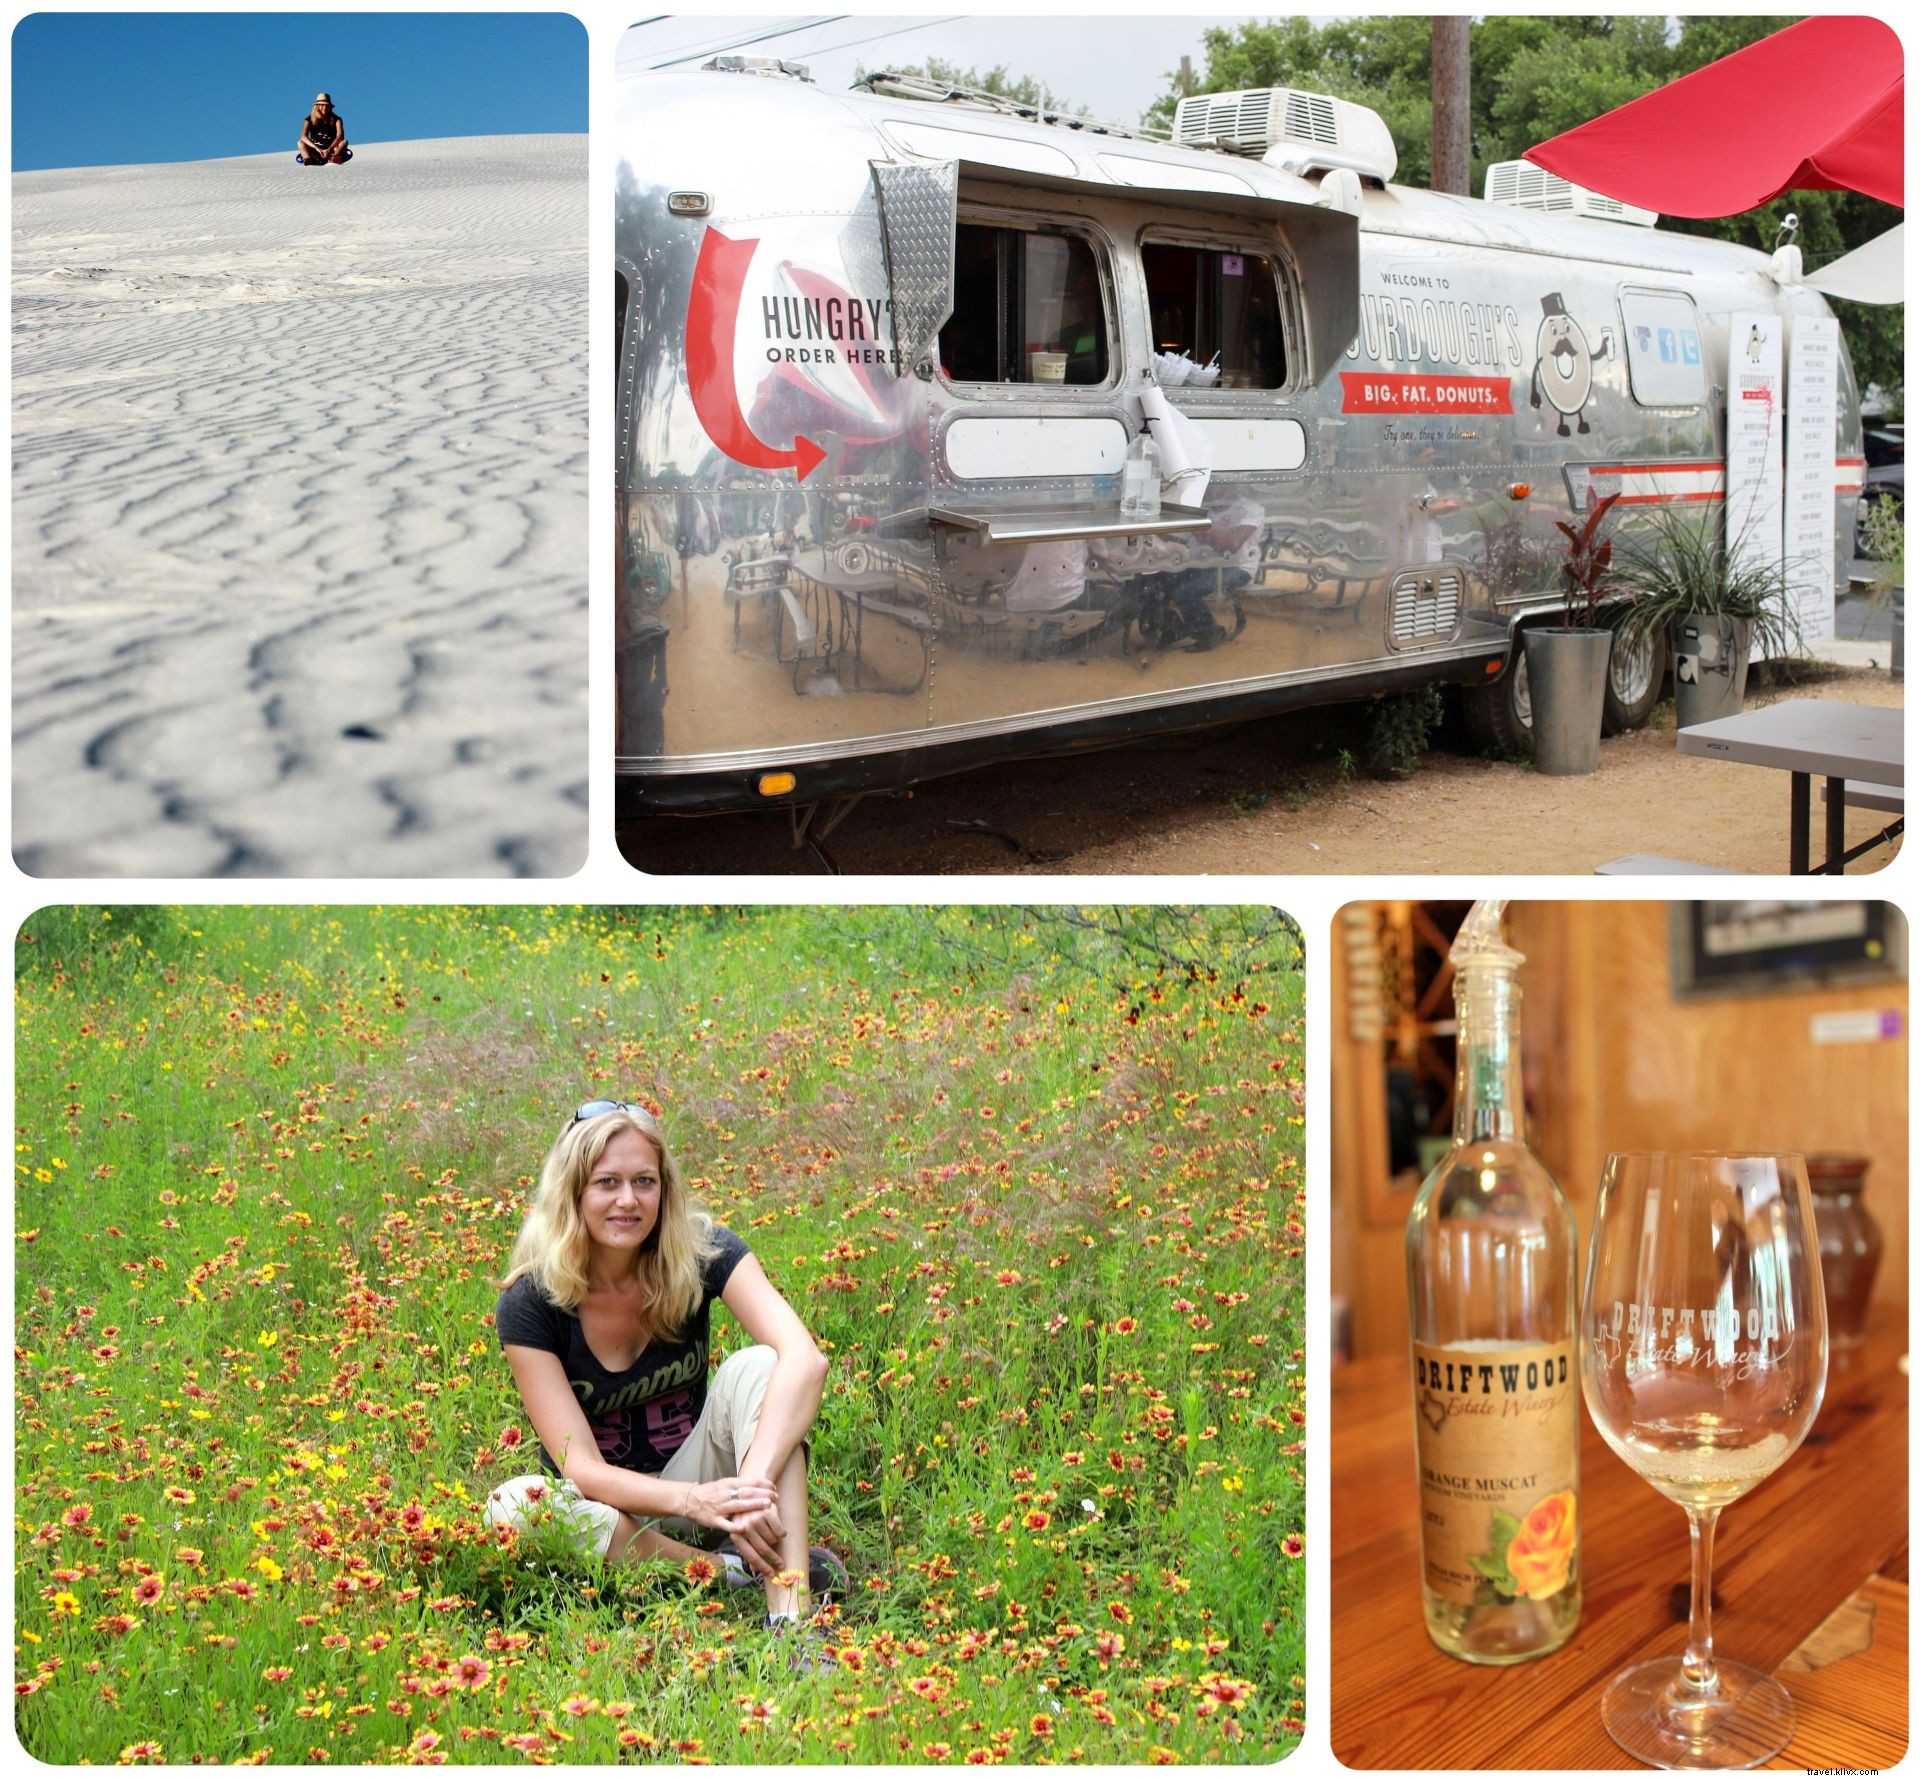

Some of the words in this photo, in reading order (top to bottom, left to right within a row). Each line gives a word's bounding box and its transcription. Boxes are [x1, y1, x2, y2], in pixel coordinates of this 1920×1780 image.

[1381, 272, 1433, 288] WELCOME
[1436, 278, 1450, 289] TO
[1345, 294, 1522, 366] URDOUGH'S
[766, 348, 836, 364] ORDER
[1364, 385, 1397, 402] BIG.
[1402, 385, 1431, 402] FAT.
[1436, 386, 1497, 403] DONUTS.
[1383, 424, 1398, 446] Try
[1613, 1301, 1779, 1341] DRIFTWOOD
[1417, 1355, 1567, 1393] DRIFTWOOD
[1446, 1396, 1495, 1416] Estate
[1501, 1391, 1567, 1425] Winery
[1476, 1475, 1538, 1491] MUSCAT
